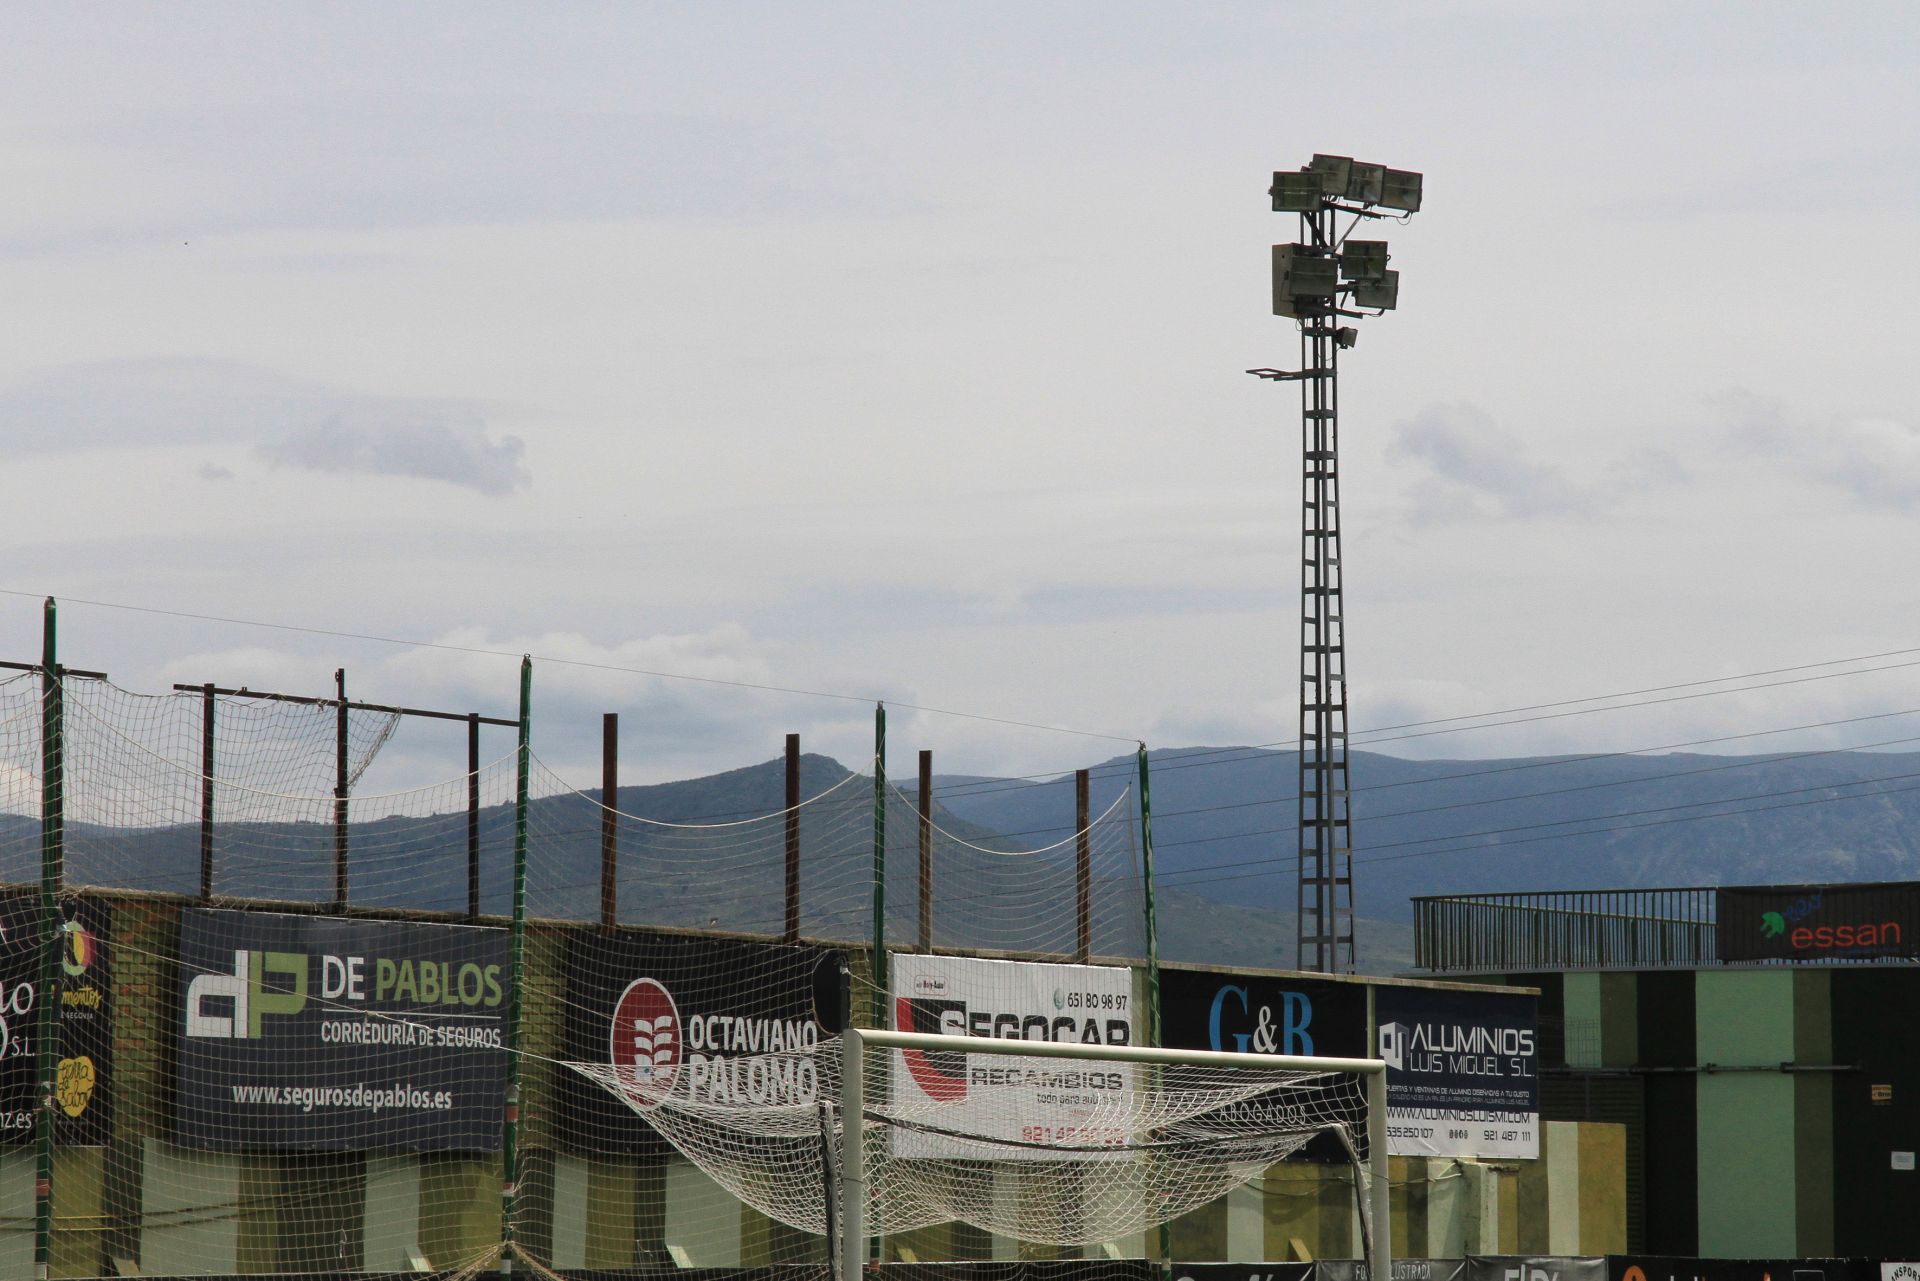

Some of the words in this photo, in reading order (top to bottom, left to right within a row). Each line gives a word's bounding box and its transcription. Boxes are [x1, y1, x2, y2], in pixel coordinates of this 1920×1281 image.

[1791, 921, 1901, 949] essan
[322, 954, 365, 1000] DE
[375, 958, 502, 1006] PABLOS
[1068, 992, 1083, 1008] 651
[1086, 993, 1099, 1008] 80
[1101, 994, 1113, 1009] 98
[1115, 995, 1127, 1010] 97
[11, 1035, 36, 1057] S.L.
[321, 1018, 416, 1046] CORREDURÍA
[419, 1027, 435, 1046] DE
[437, 1027, 502, 1049] SEGUROS
[689, 1014, 818, 1052] OCTAVIANO
[1410, 1022, 1535, 1056] ALUMINIOS
[1410, 1052, 1443, 1073] LUIS
[1449, 1055, 1504, 1077] MIGUEL
[1510, 1058, 1535, 1077] S.L.
[689, 1054, 818, 1105] PALOMO
[971, 1067, 1123, 1090] RECAMBIOS
[232, 1083, 452, 1113] www.segurosdepablos.es
[1036, 1093, 1058, 1104] todo
[1059, 1094, 1081, 1106] para
[1220, 1103, 1306, 1124] ABOGADOS
[1484, 1130, 1498, 1141] 921
[1501, 1131, 1518, 1141] 487
